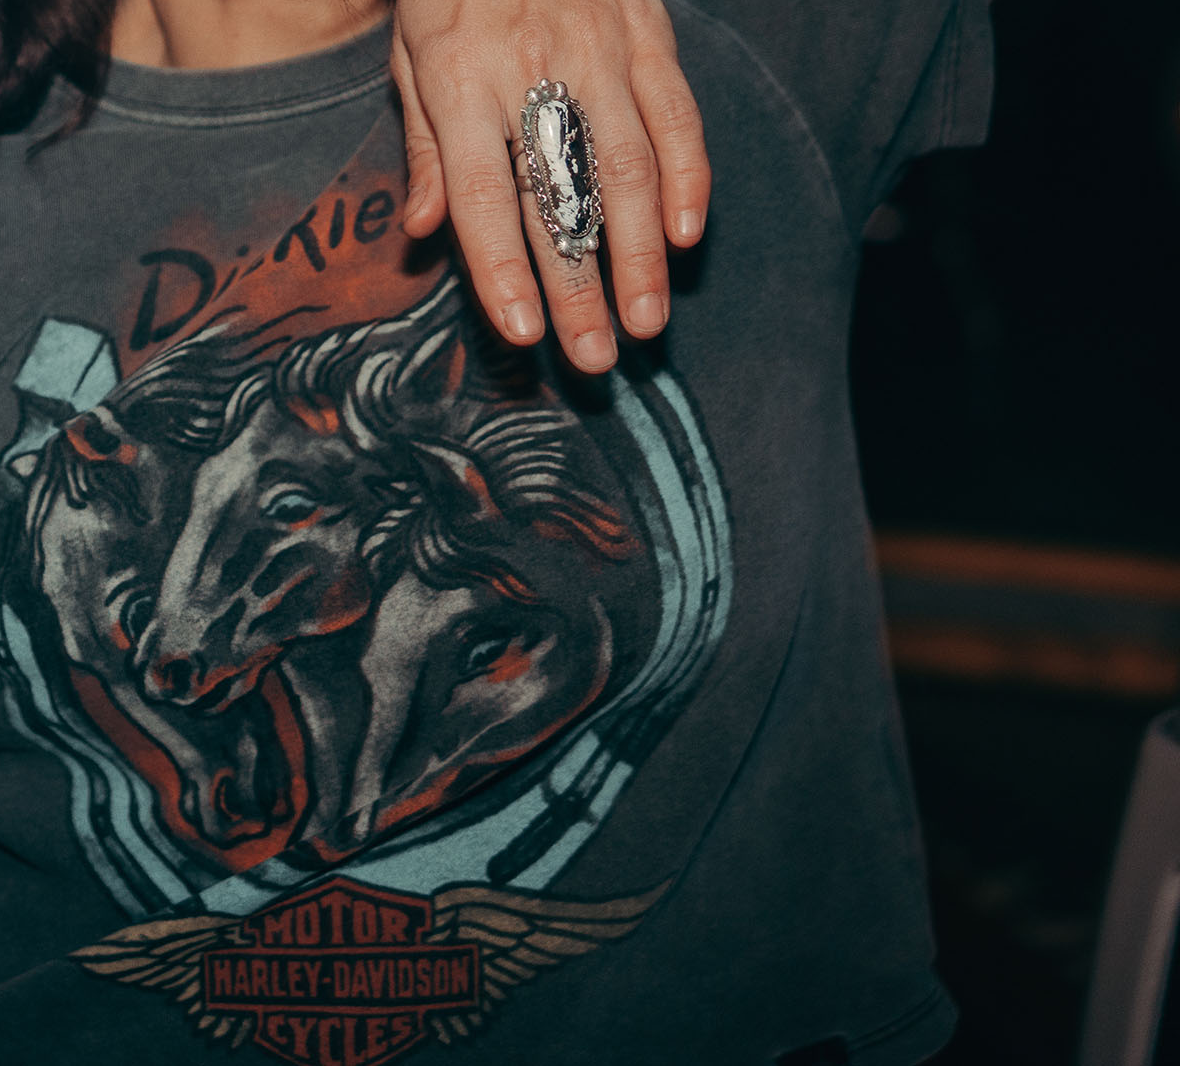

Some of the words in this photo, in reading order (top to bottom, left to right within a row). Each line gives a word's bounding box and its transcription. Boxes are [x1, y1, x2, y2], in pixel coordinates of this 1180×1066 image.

[264, 890, 410, 945] MOTOR
[213, 956, 471, 999] HARLEY-DAVIDSON
[267, 1014, 413, 1066] CYCLES
